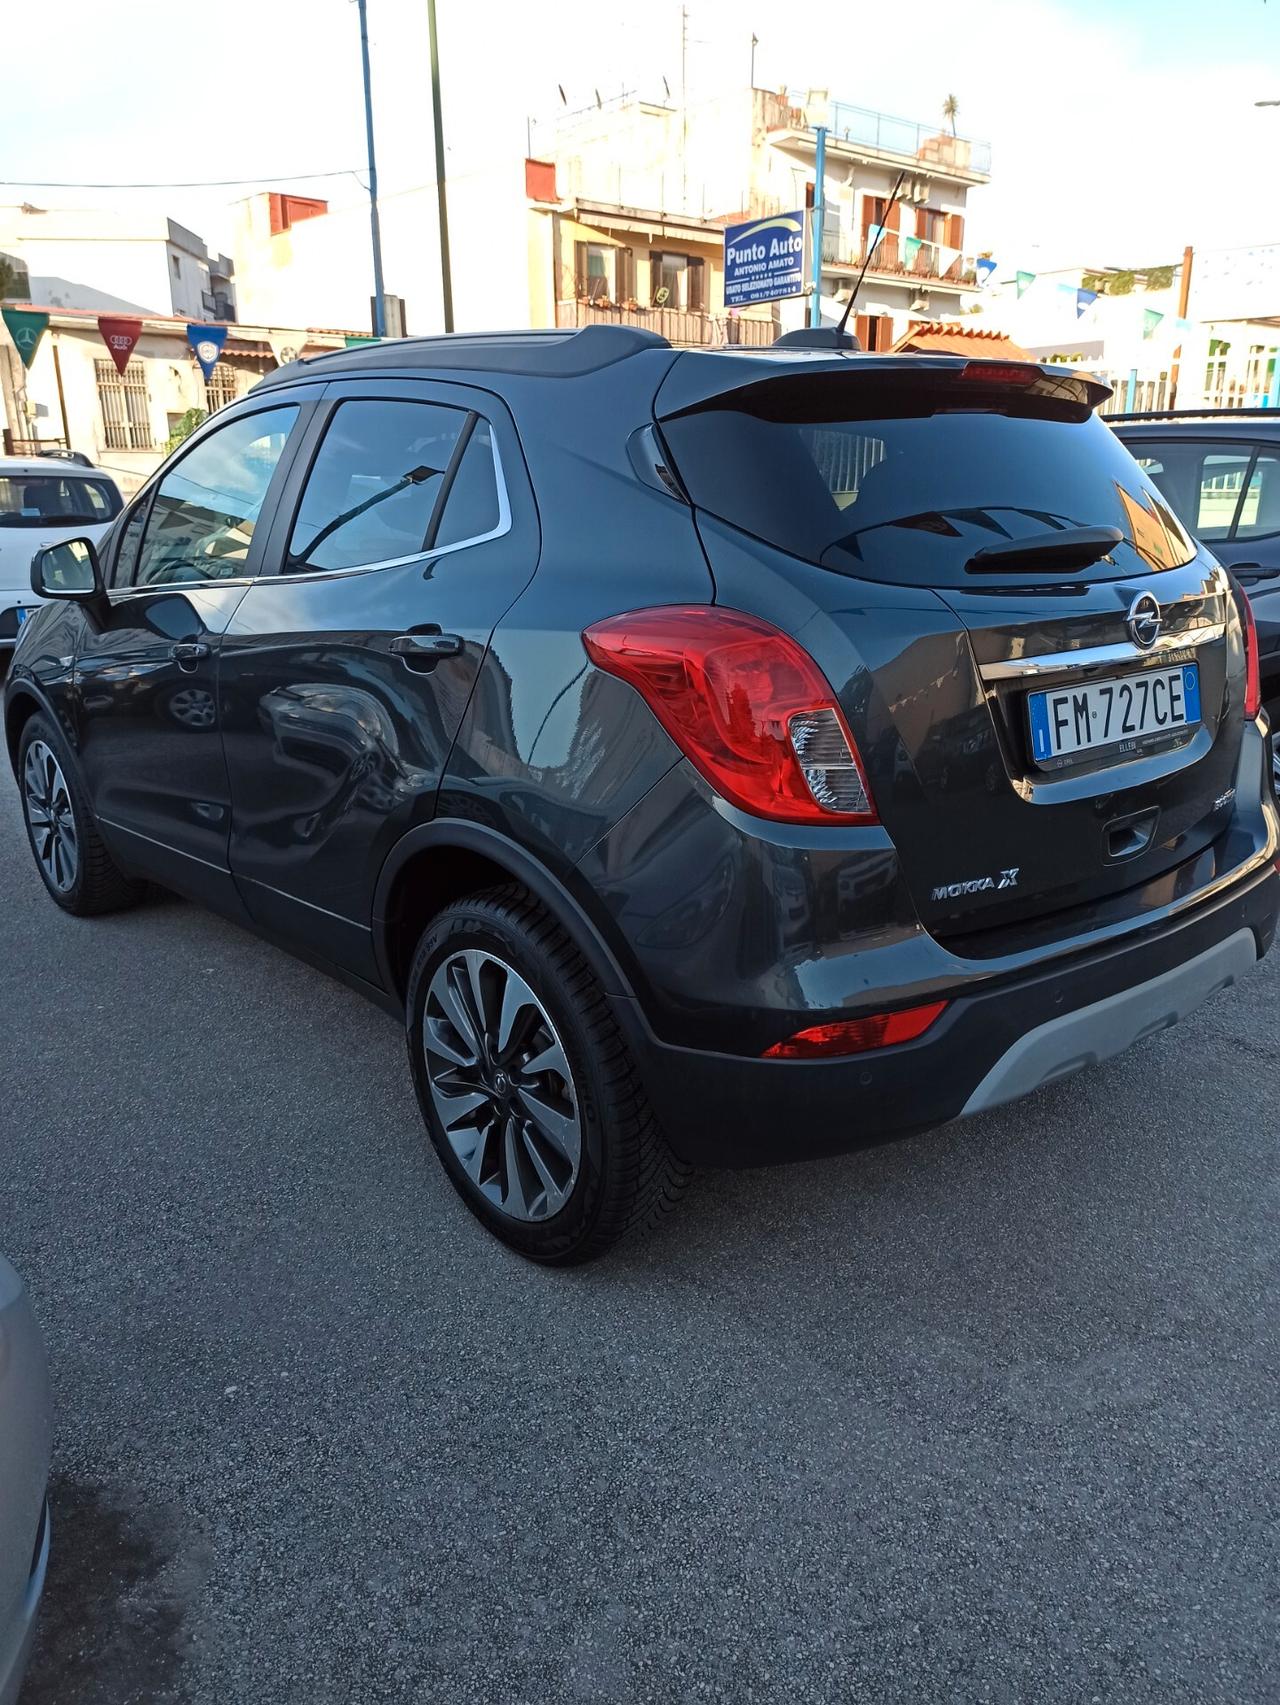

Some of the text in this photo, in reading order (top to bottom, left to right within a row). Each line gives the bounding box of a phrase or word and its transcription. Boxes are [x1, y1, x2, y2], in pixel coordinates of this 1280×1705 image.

[727, 235, 803, 266] Punto Auto
[734, 256, 794, 276] ANTONIO AMATO
[1053, 674, 1185, 750] FM 727CE
[931, 868, 1020, 901] MOKKA X
